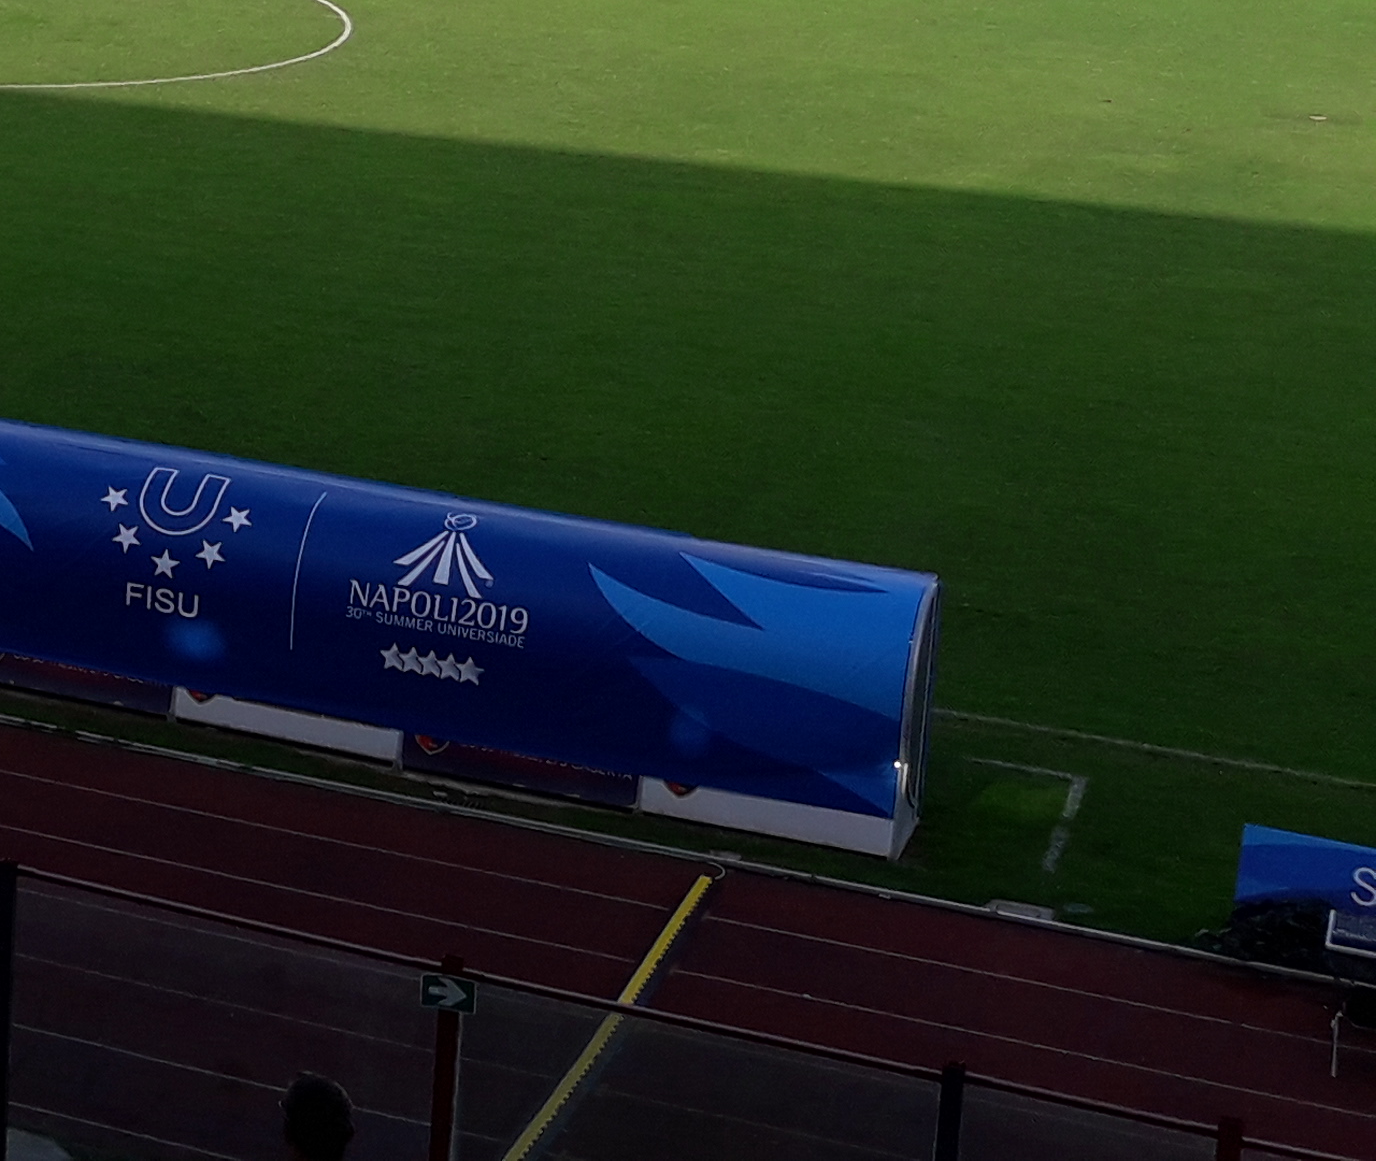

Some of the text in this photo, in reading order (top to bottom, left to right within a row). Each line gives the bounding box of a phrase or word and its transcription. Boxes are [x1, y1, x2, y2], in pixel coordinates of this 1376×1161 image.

[126, 581, 199, 618] FISU
[349, 579, 529, 635] NAPOLI2019
[375, 611, 434, 633] SUMMER
[438, 623, 526, 649] UNIVERSIADE
